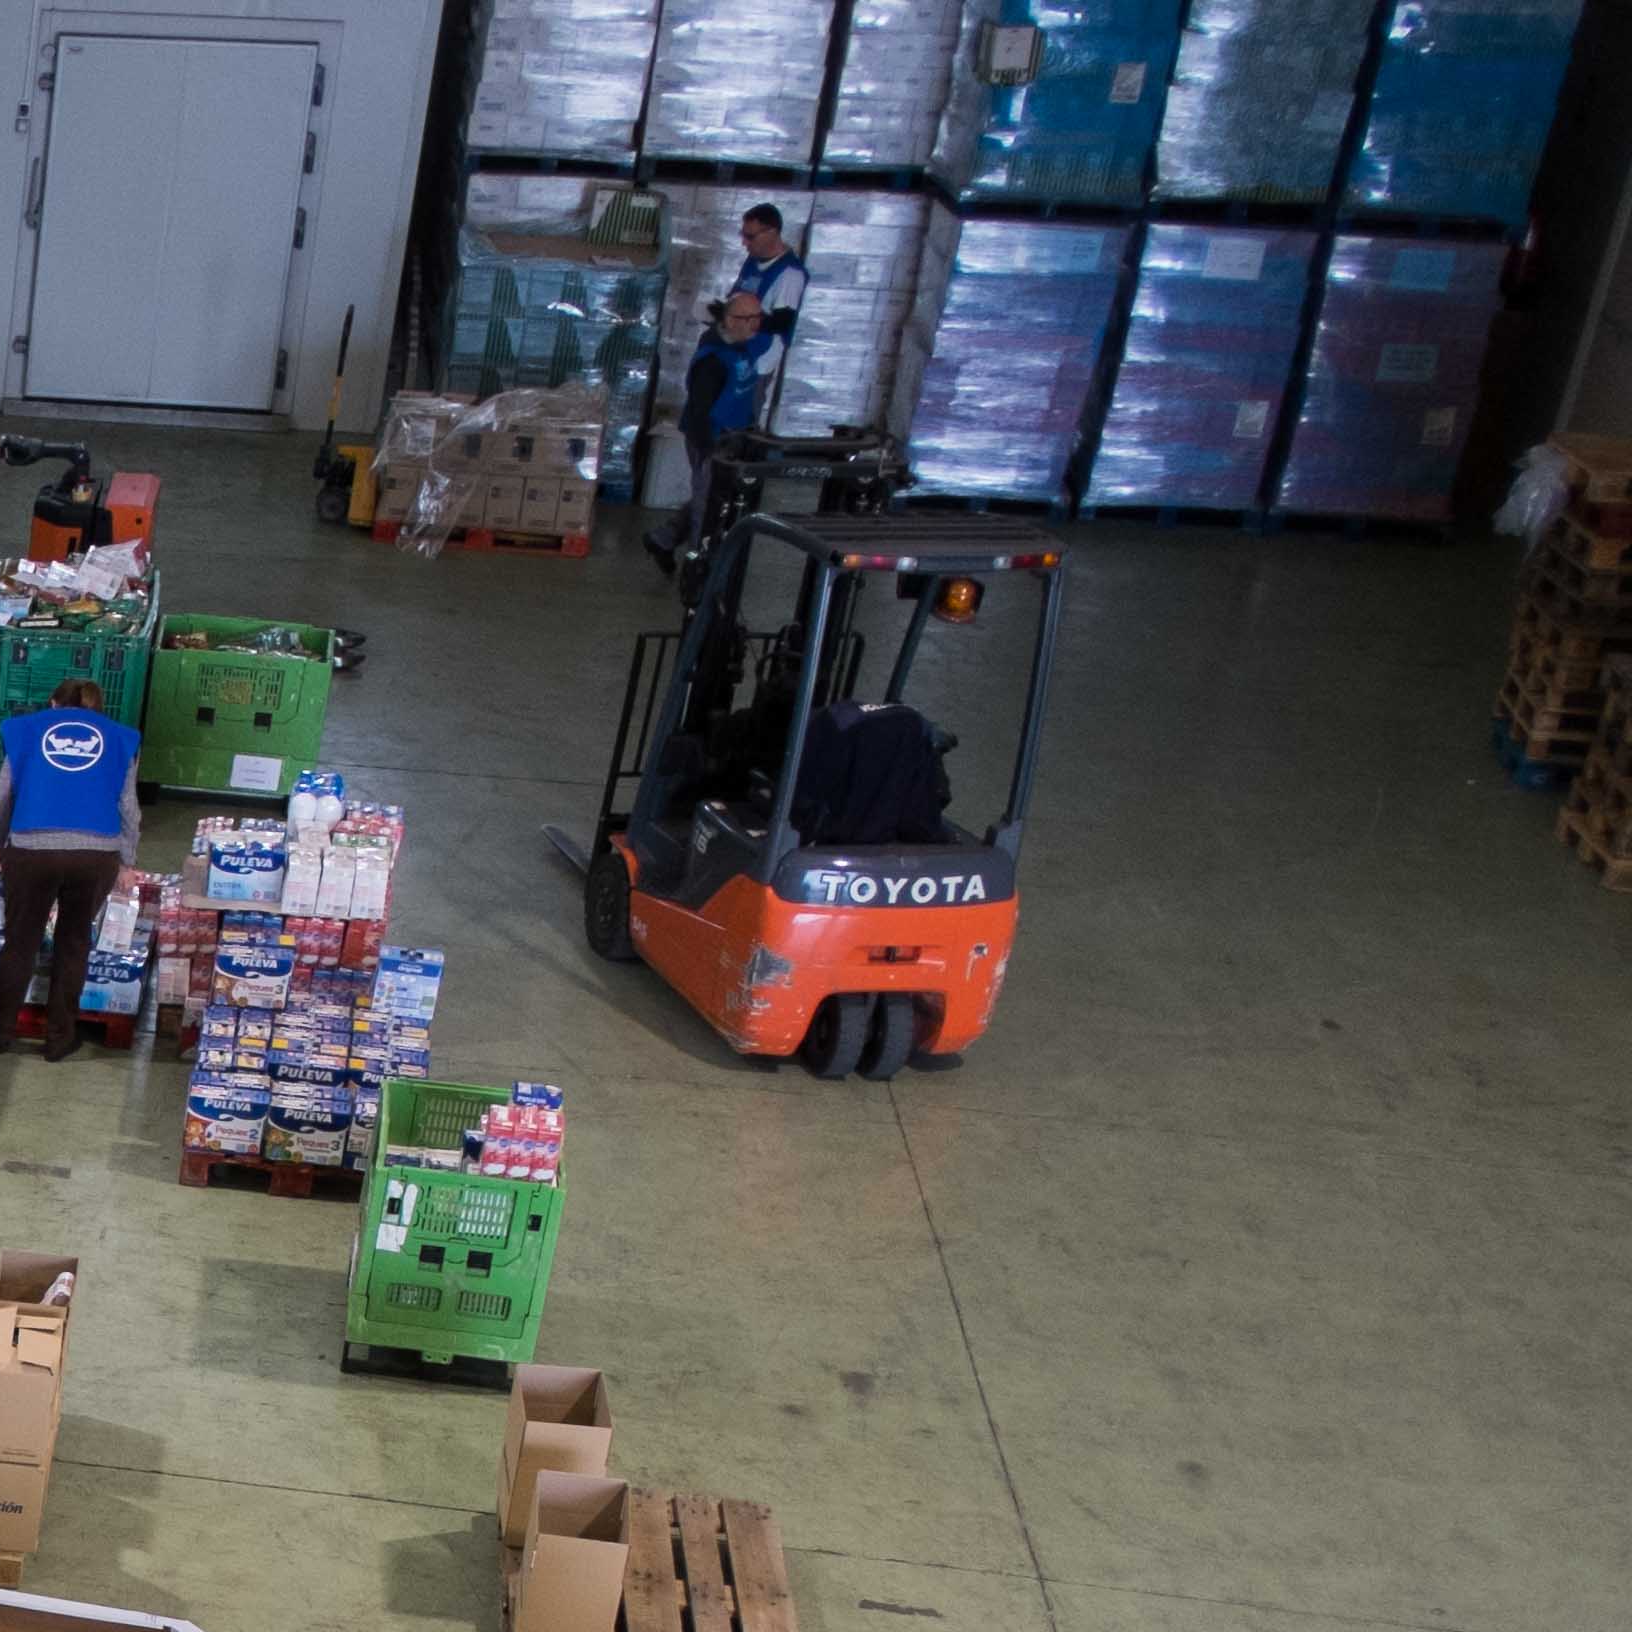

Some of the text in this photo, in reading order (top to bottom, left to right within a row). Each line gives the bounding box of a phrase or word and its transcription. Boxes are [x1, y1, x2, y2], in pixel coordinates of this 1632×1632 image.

[221, 855, 273, 868] PULEVA
[822, 873, 987, 905] TOYOTA
[232, 953, 279, 969] PULEVA
[88, 966, 130, 980] ULEVA
[274, 985, 284, 995] 3
[277, 1065, 333, 1082] PULEVA
[204, 1098, 251, 1113] PULEVA
[284, 1109, 333, 1124] PULEVA
[249, 1128, 258, 1138] 2
[330, 1140, 340, 1151] 3
